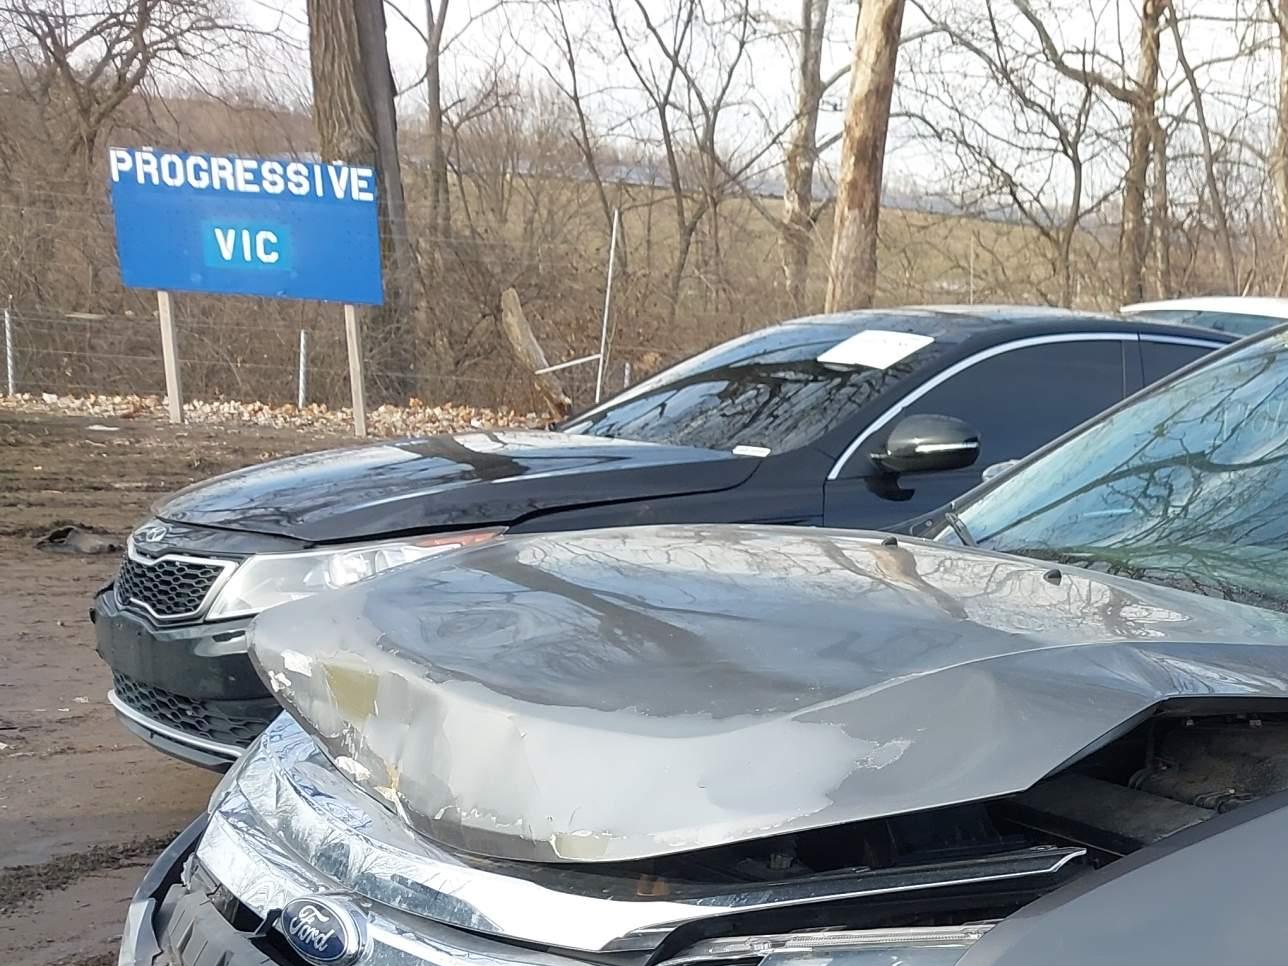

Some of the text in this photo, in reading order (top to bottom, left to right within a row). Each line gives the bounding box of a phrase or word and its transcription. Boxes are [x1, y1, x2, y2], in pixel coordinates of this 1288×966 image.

[109, 148, 374, 201] PROGRESSIVE
[214, 227, 279, 264] VIC
[289, 904, 335, 952] Ford
